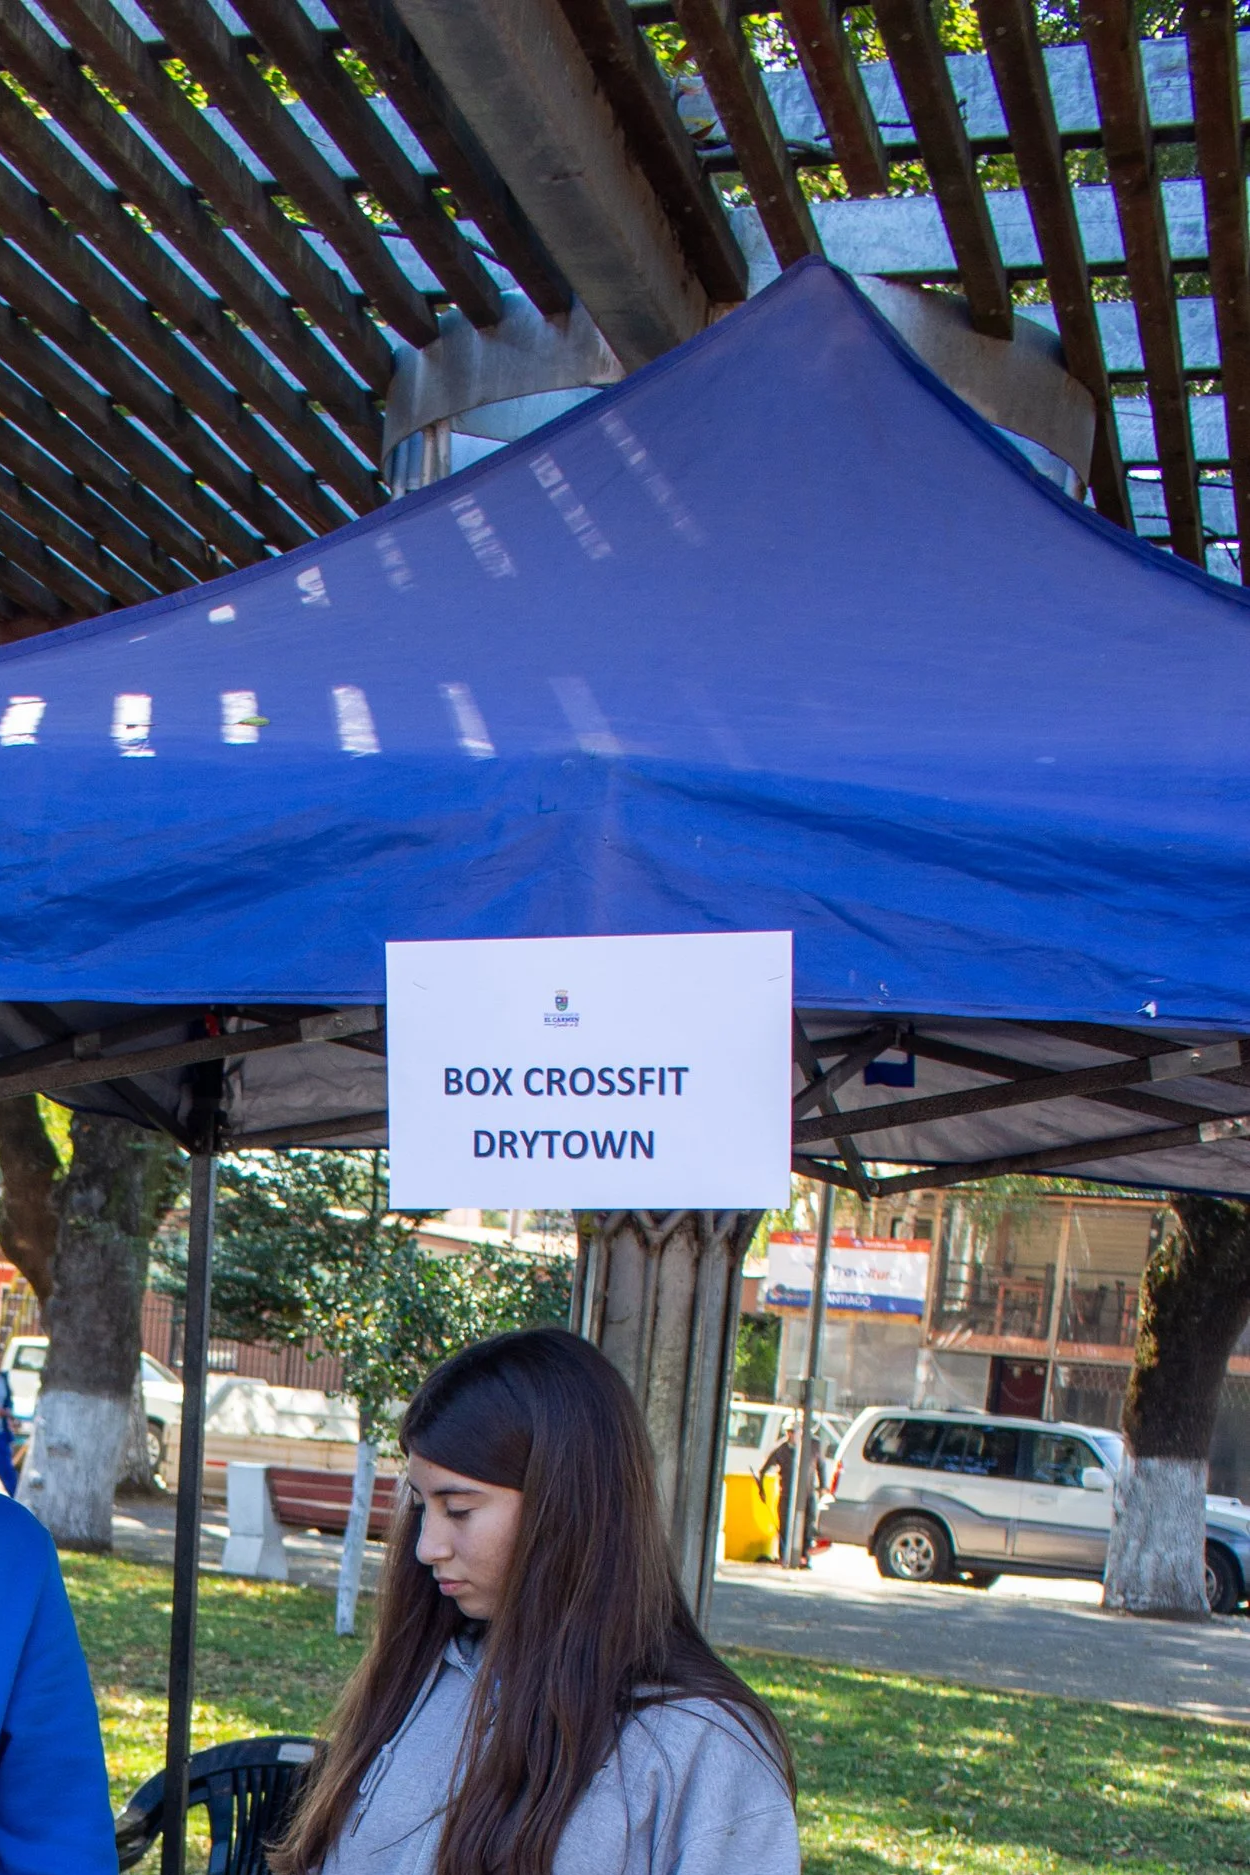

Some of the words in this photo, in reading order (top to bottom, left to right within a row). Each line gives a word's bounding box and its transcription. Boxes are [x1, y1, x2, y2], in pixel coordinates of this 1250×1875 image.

[444, 1067, 513, 1096] BOX
[523, 1066, 689, 1097] CROSSFIT
[473, 1130, 654, 1159] DRYTOWN
